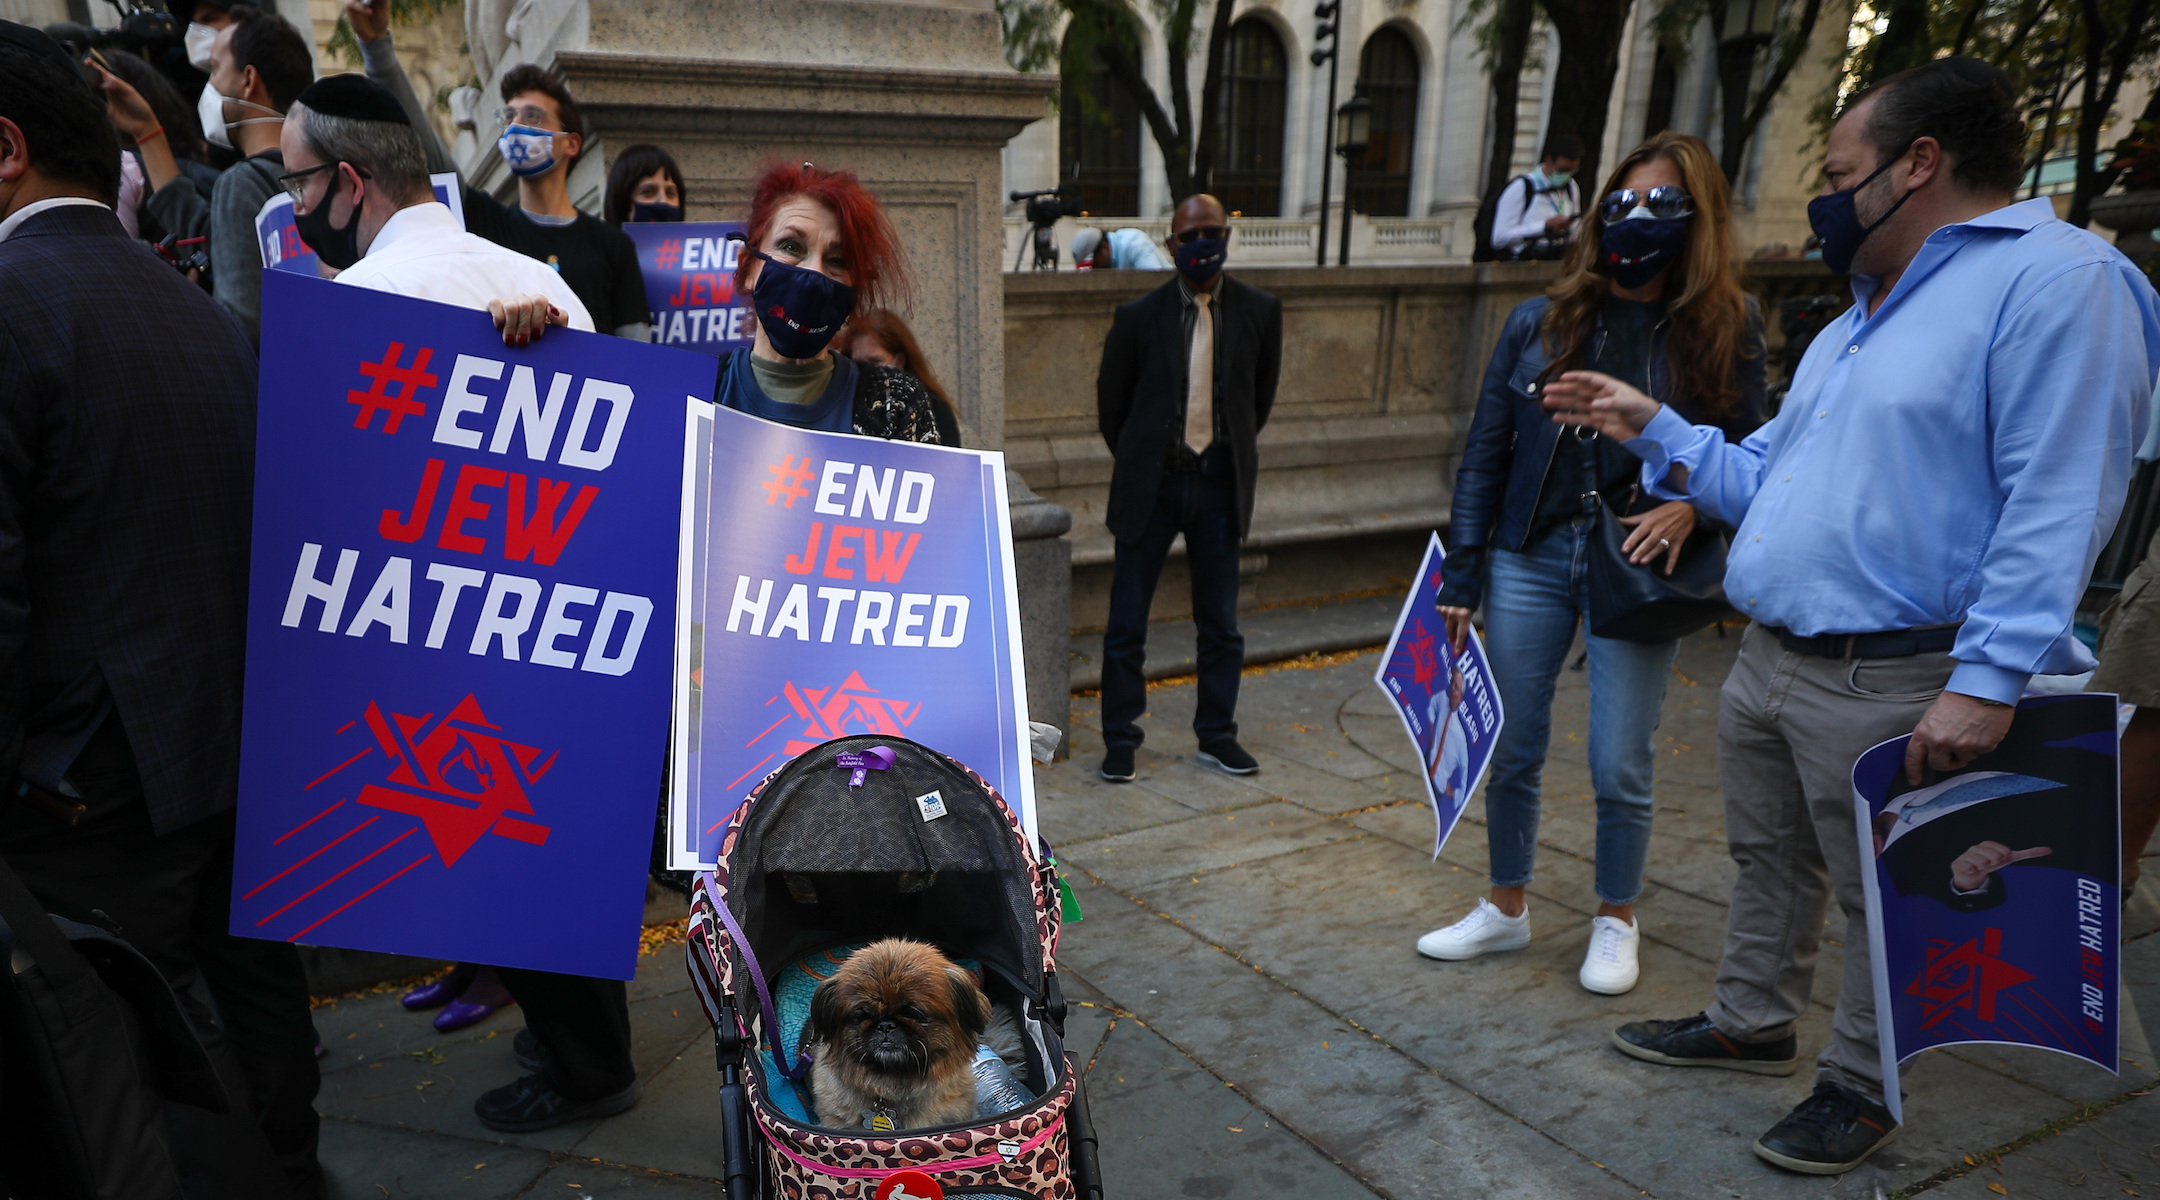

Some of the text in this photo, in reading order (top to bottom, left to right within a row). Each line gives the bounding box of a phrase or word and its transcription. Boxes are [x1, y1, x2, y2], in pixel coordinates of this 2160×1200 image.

[649, 307, 755, 344] HATRE
[669, 272, 735, 306] JEW
[346, 340, 636, 472] #END
[377, 457, 601, 567] JEW
[761, 453, 936, 525] #END
[784, 521, 923, 584] JEW
[280, 541, 655, 677] HATRED
[725, 574, 971, 648] HATRED
[1456, 649, 1495, 735] HATRED
